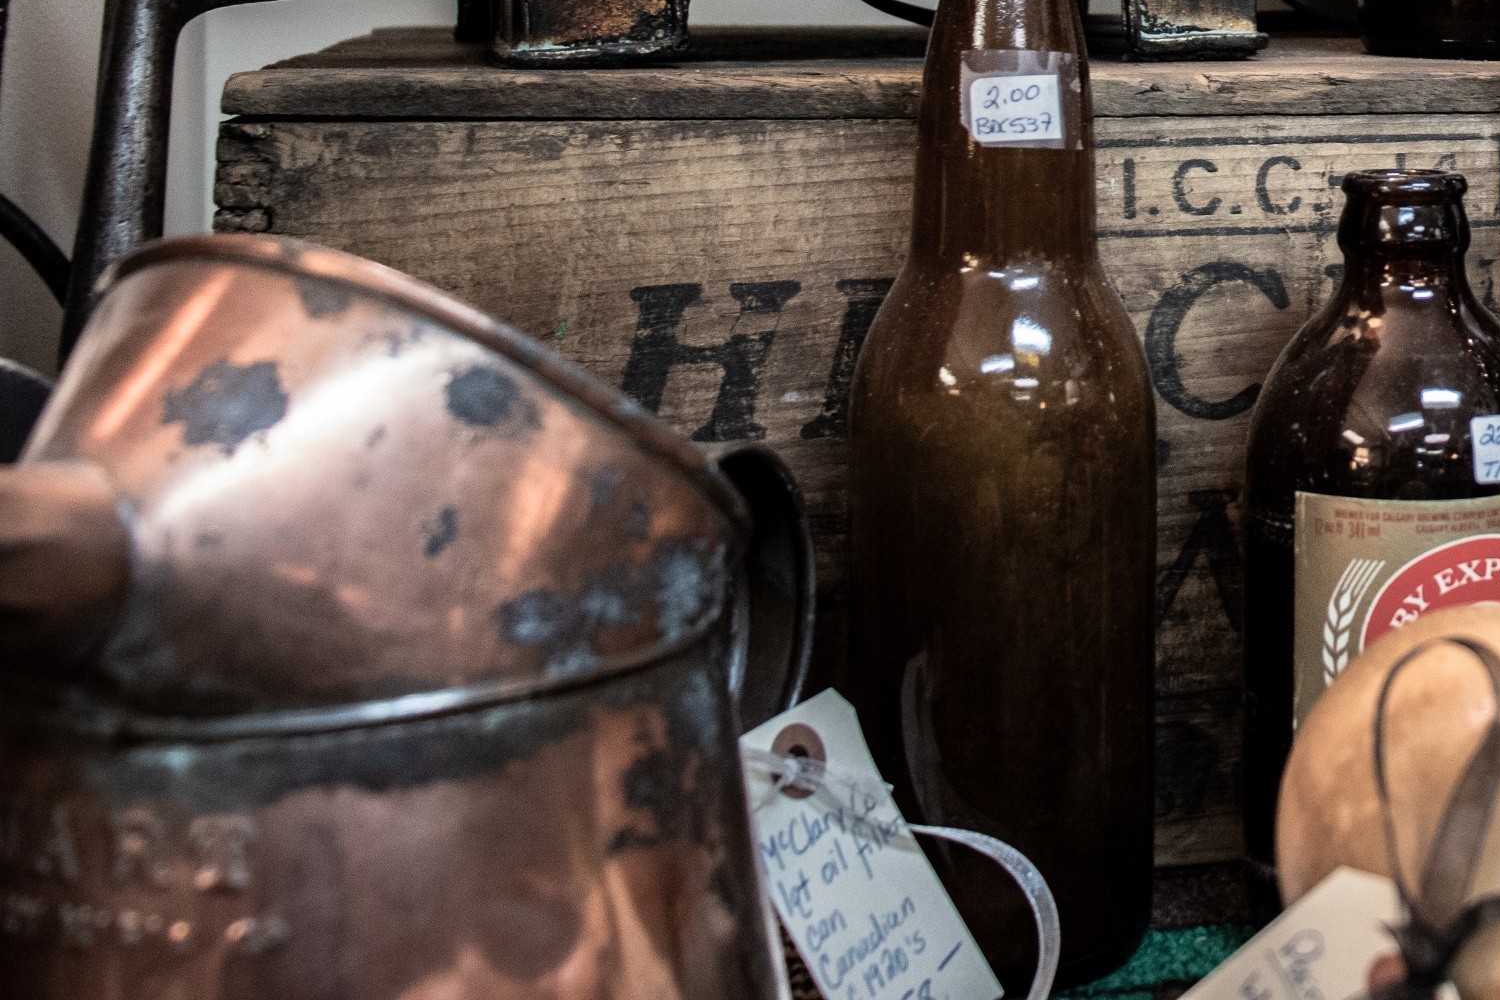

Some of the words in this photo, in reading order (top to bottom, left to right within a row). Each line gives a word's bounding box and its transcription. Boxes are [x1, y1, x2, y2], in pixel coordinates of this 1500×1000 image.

[983, 84, 1040, 109] 2.00
[805, 908, 848, 952] can
[818, 895, 917, 991] Canadian
